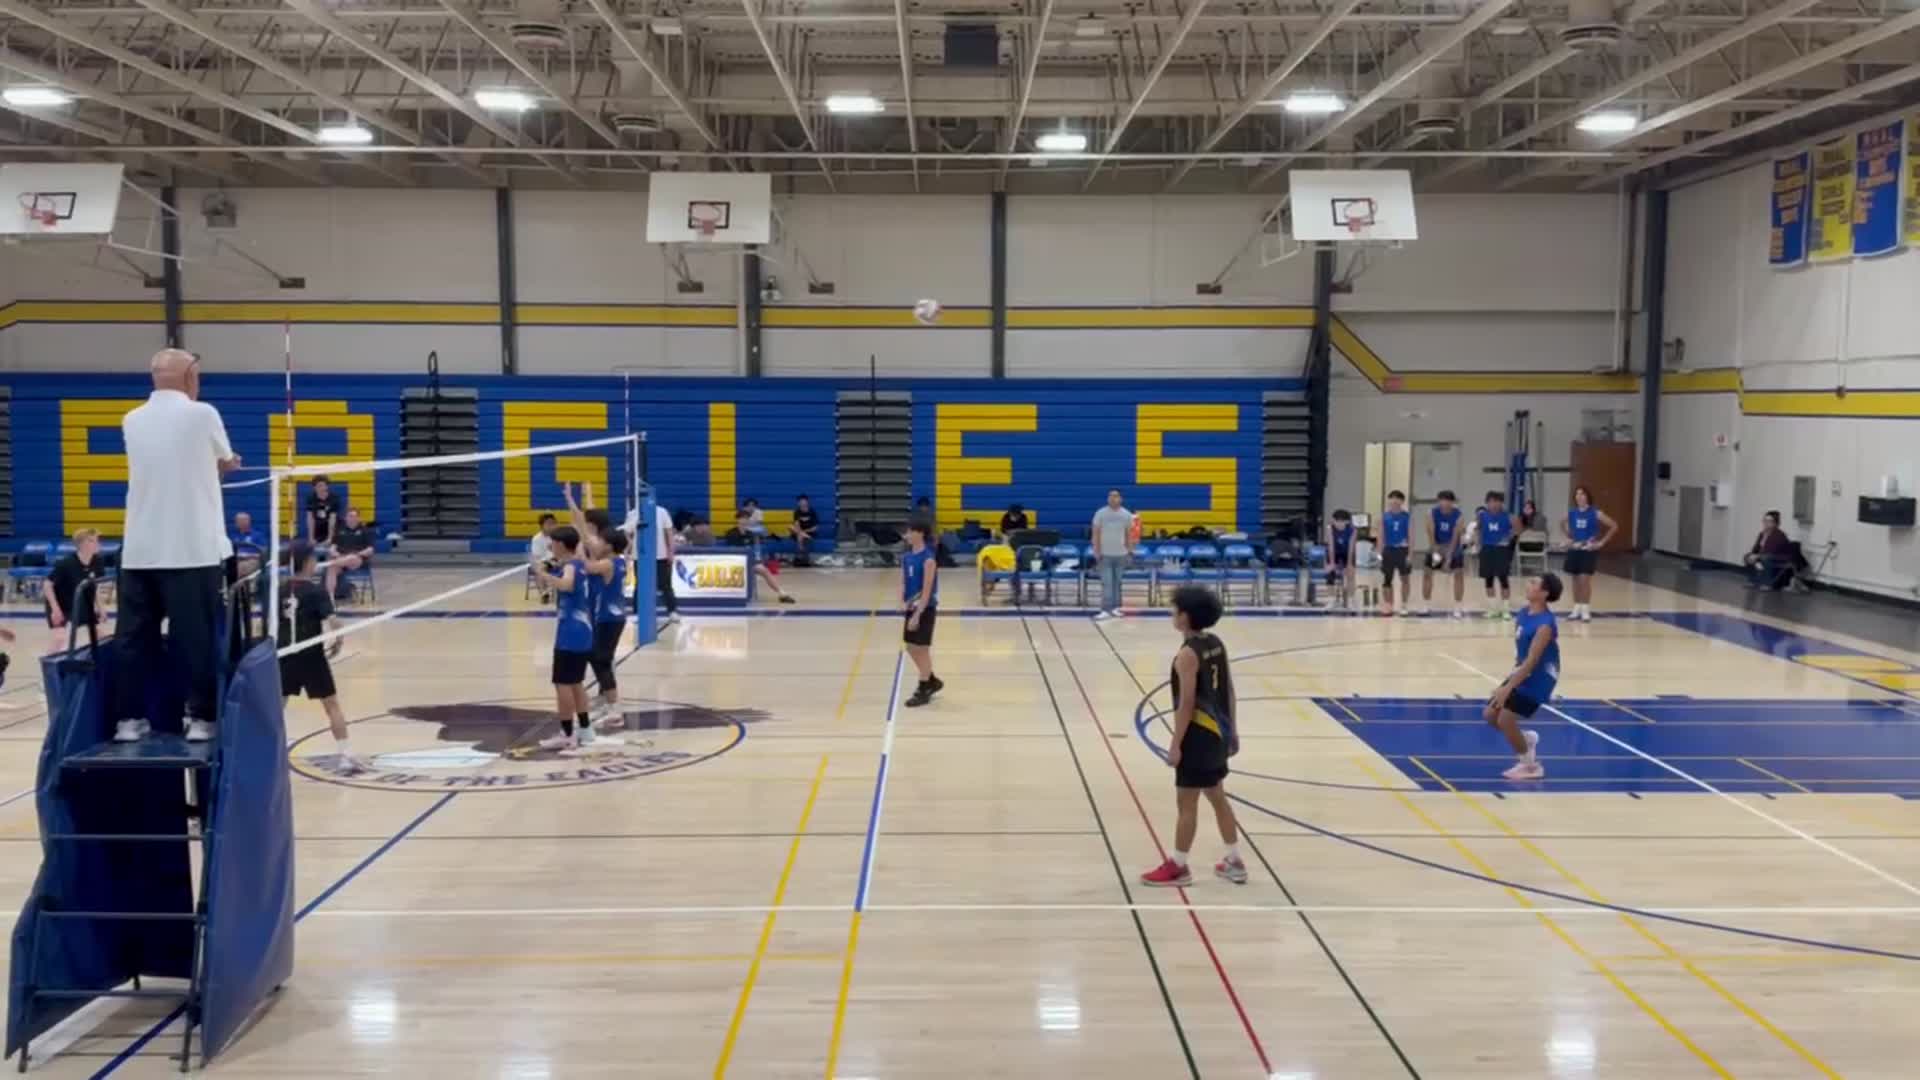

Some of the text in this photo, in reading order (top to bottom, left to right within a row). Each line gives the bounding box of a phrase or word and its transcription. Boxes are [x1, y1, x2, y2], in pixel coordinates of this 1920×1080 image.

[60, 399, 1238, 537] EAGLES
[442, 775, 528, 787] THE
[544, 751, 692, 782] EAGLES
